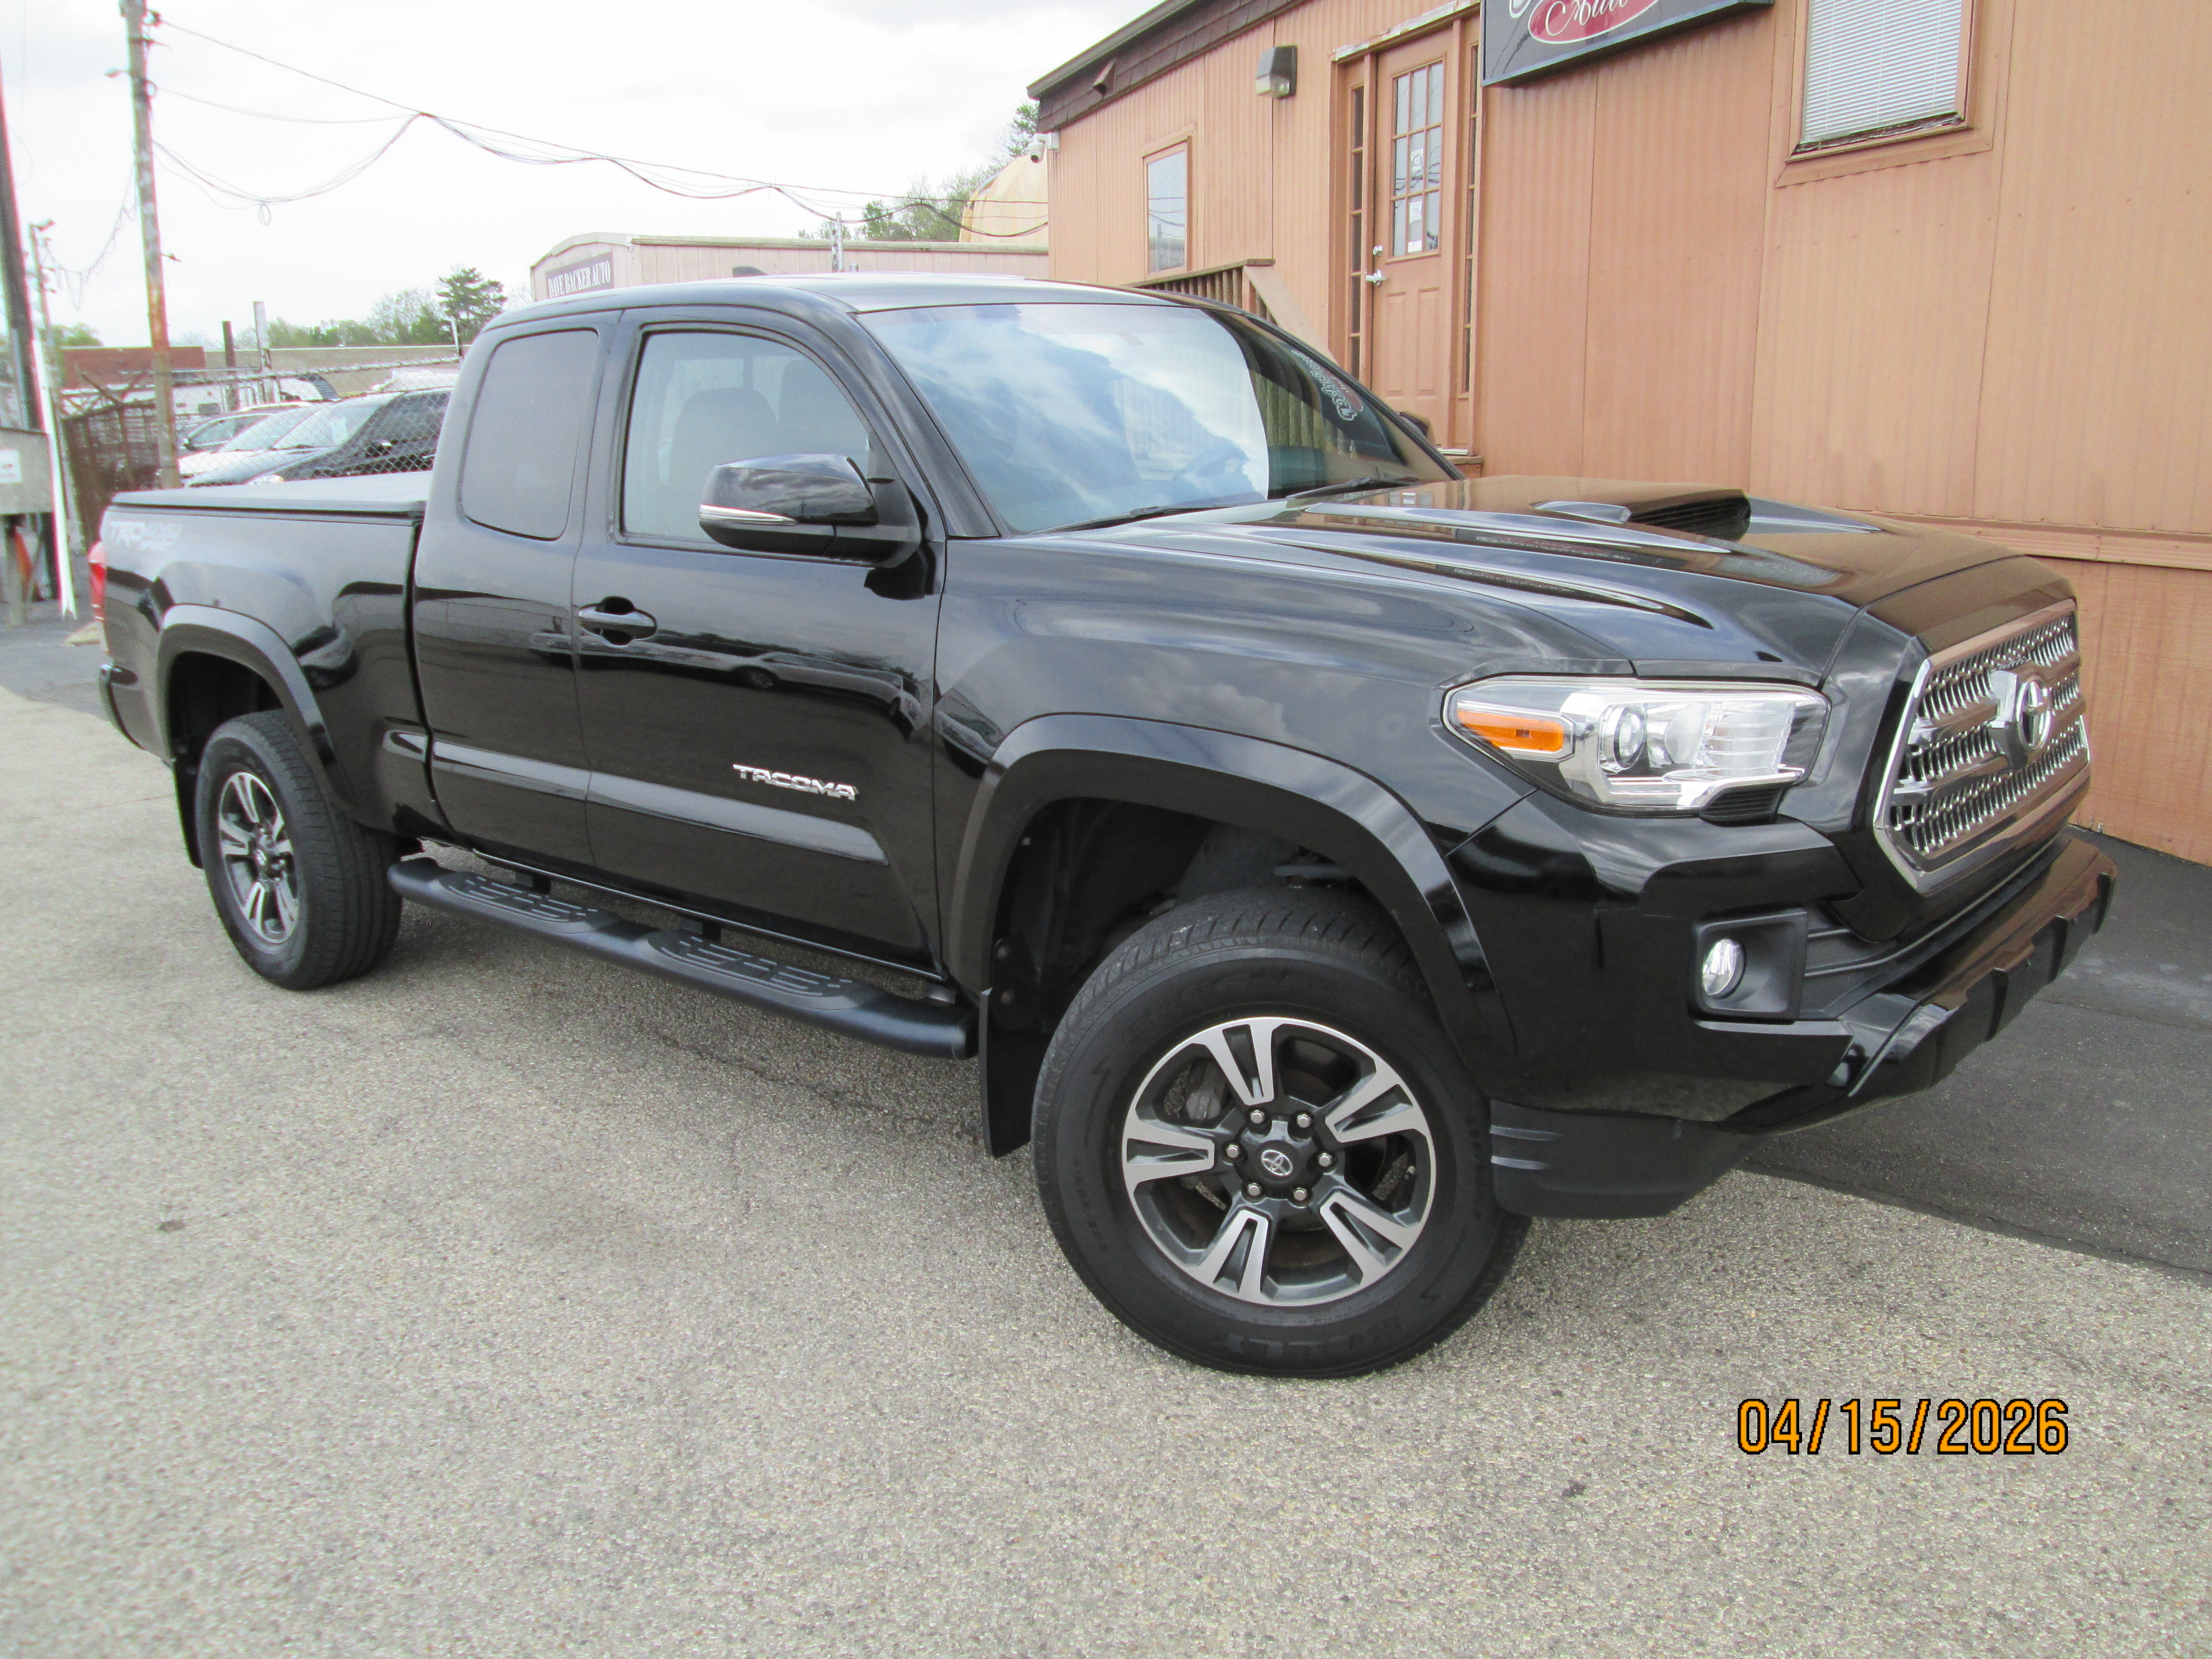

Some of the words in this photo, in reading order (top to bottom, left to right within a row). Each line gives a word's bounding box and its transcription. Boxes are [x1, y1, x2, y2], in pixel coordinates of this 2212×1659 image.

[548, 275, 565, 298] DAVE
[564, 267, 591, 293] BACKER
[592, 260, 611, 286] AUTO
[733, 763, 859, 801] TACOMA
